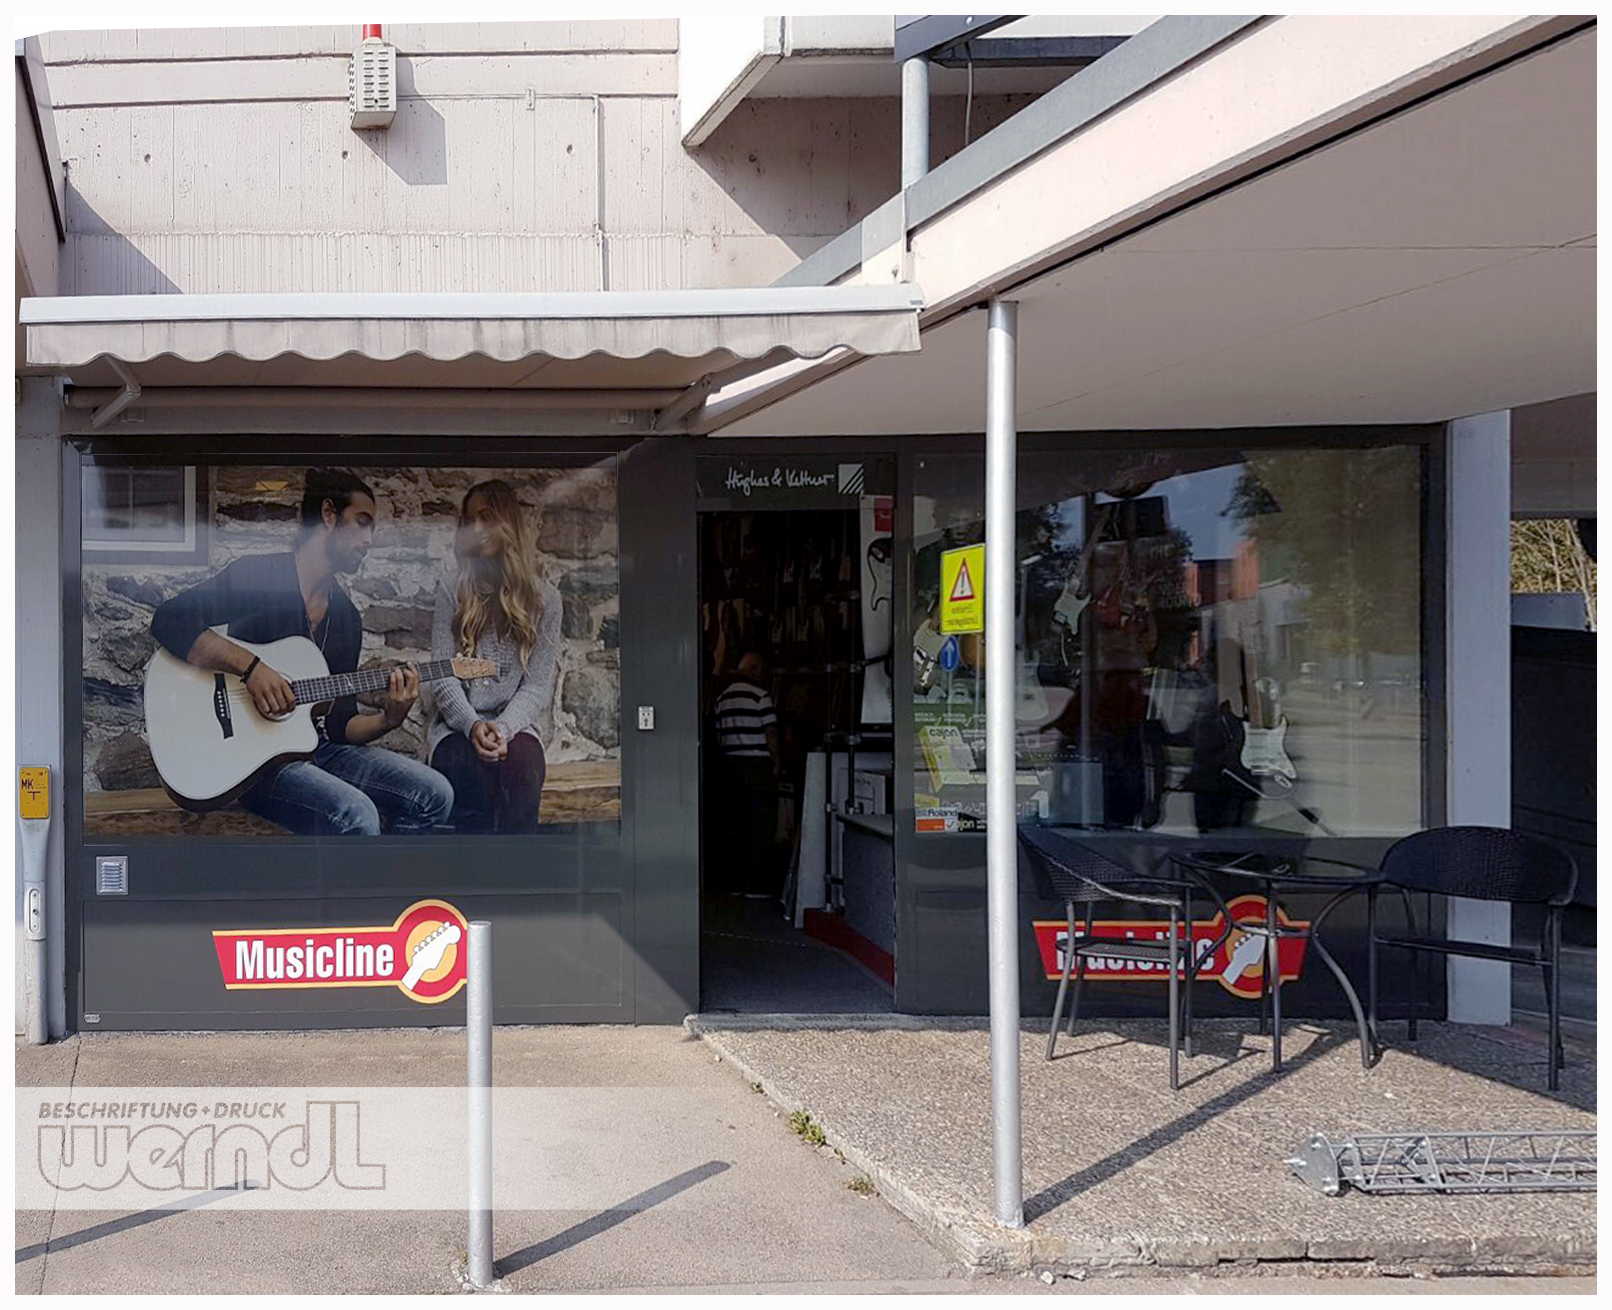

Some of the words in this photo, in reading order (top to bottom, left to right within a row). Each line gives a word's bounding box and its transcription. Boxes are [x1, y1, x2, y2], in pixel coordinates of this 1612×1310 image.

[725, 467, 769, 496] Hughes
[771, 467, 782, 487] &
[930, 728, 958, 739] cajon
[21, 779, 34, 790] MK
[928, 808, 958, 818] Roland
[235, 937, 394, 980] Musicline
